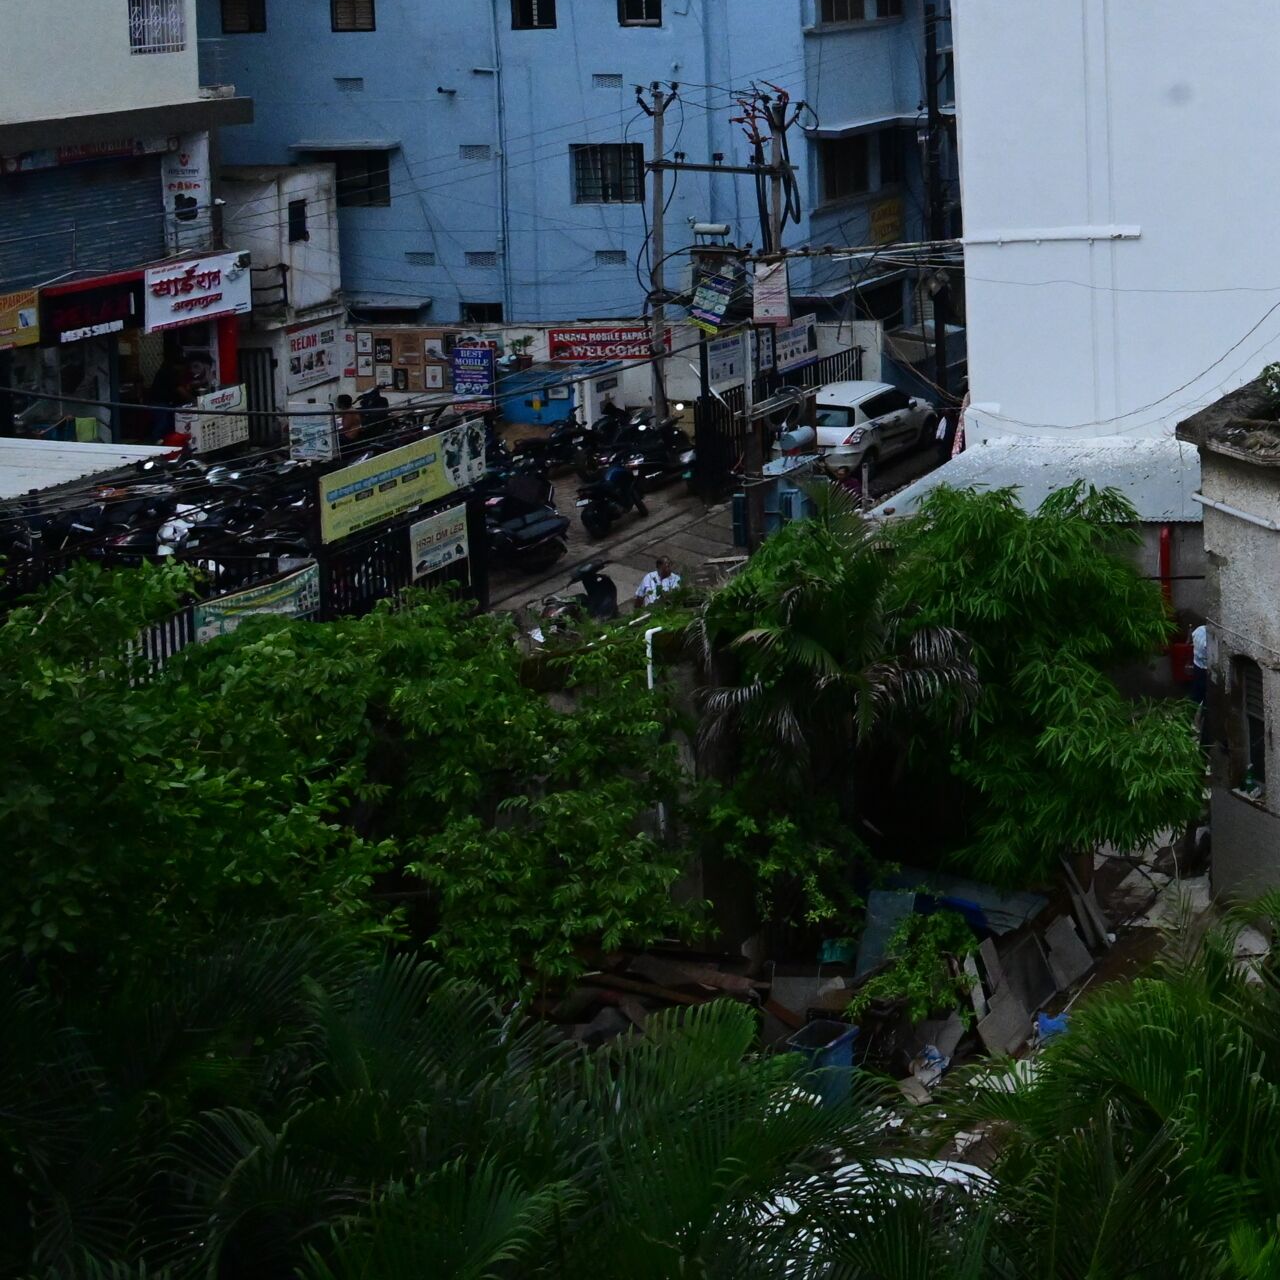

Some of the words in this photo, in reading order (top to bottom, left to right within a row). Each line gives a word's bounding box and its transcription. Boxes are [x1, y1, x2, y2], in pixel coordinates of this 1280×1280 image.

[460, 349, 484, 359] BEST
[572, 343, 651, 357] WELCOME
[454, 357, 490, 368] MOBILE
